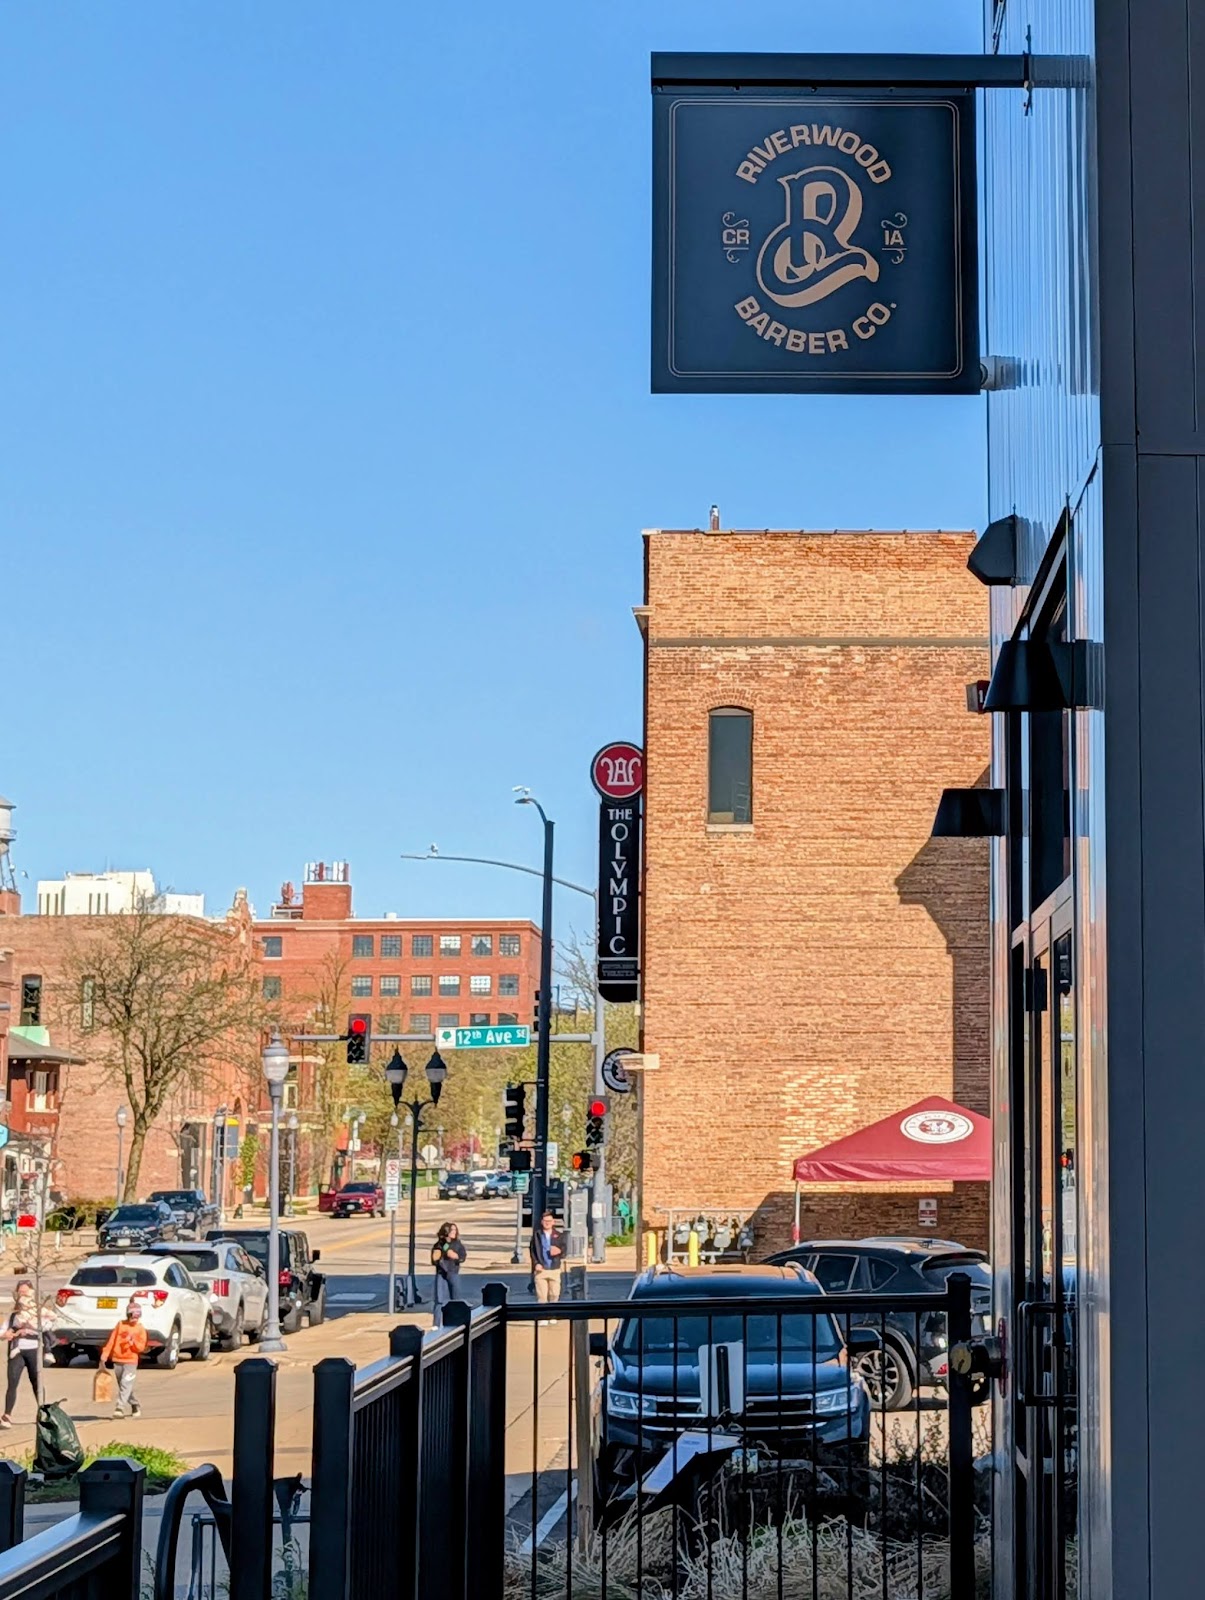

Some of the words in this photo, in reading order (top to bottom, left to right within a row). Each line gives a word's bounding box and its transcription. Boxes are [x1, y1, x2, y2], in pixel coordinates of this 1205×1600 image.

[735, 123, 892, 184] RIVERWOOD
[722, 229, 750, 245] CR
[884, 229, 905, 246] IA
[734, 295, 849, 354] BARBER
[852, 301, 898, 340] CO.
[607, 808, 633, 821] THE
[608, 823, 629, 955] OLYMPIC
[457, 1029, 482, 1045] 12th
[485, 1029, 512, 1044] Ave
